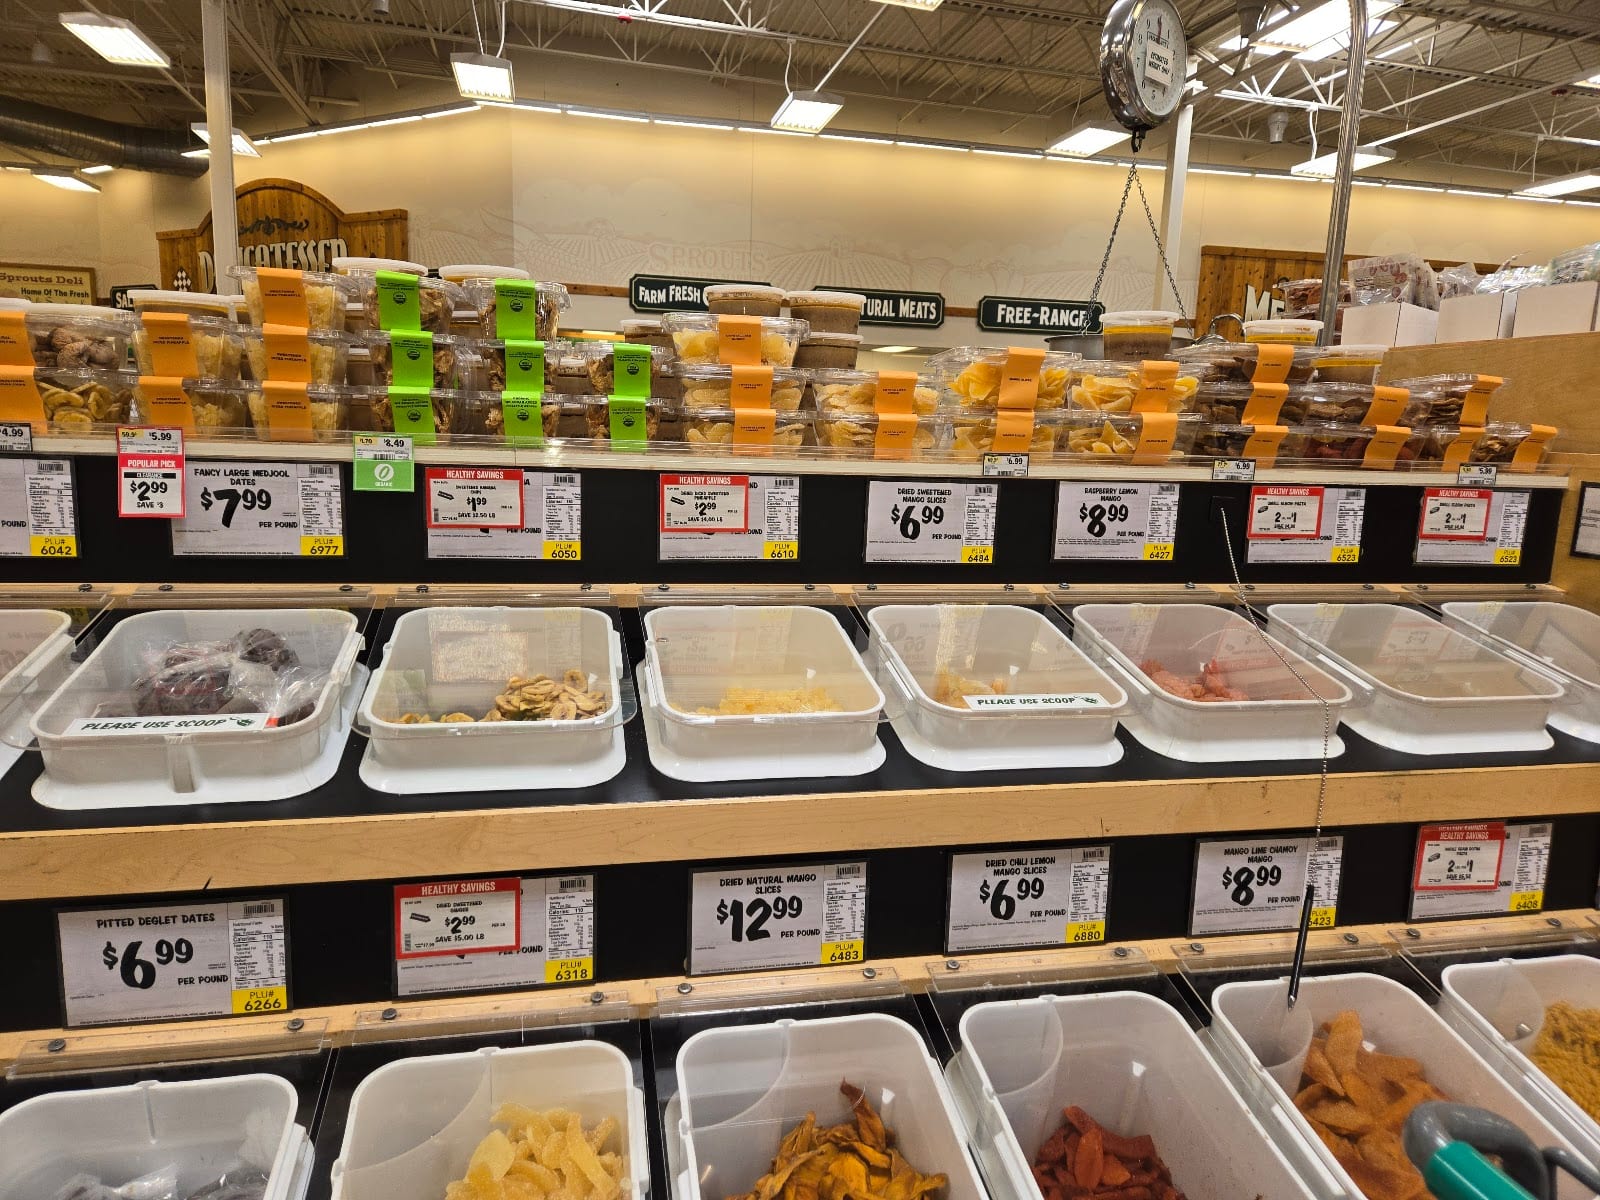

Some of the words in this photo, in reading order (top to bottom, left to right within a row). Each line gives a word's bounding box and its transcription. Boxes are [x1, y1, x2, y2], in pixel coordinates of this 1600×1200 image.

[56, 276, 84, 284] Deli
[21, 288, 42, 296] Home
[639, 286, 666, 304] FARM
[669, 284, 700, 304] FRESH
[860, 300, 896, 317] TURAL
[900, 299, 937, 320] MEATS
[128, 460, 158, 468] POPULAR
[252, 469, 290, 477] MEDJOOL
[446, 470, 475, 479] HEALTHY
[476, 470, 504, 480] SAVINGS
[706, 476, 731, 484] SAVINGS
[1275, 512, 1281, 522] 2
[1446, 514, 1452, 524] 2
[40, 546, 72, 555] 6042
[310, 546, 339, 554] 6977
[551, 550, 577, 558] 6050
[771, 550, 794, 558] 6610
[1149, 551, 1170, 559] 6427
[968, 554, 989, 562] 6484
[81, 721, 137, 730] PLEASE
[174, 719, 227, 728] SCOOP
[986, 859, 1007, 868] DRIED
[1030, 856, 1056, 865] LEMON
[1448, 860, 1455, 872] 2
[993, 868, 1020, 876] MANGO
[1023, 867, 1047, 875] SLICES
[720, 878, 744, 886] DRIED
[746, 876, 784, 886] NATURAL
[786, 874, 816, 883] MANGO
[422, 884, 459, 896] HEALTHY
[461, 882, 495, 893] SAVINGS
[755, 886, 781, 894] SLICES
[1516, 901, 1538, 910] 6408
[96, 918, 134, 928] PITTED
[139, 916, 178, 925] DEGLET
[182, 913, 215, 923] DATES
[1074, 930, 1100, 940] 6880
[830, 951, 859, 961] 6483
[178, 977, 194, 985] PER
[199, 975, 228, 984] POUND
[555, 970, 588, 981] 6318
[244, 1000, 281, 1010] 6266
